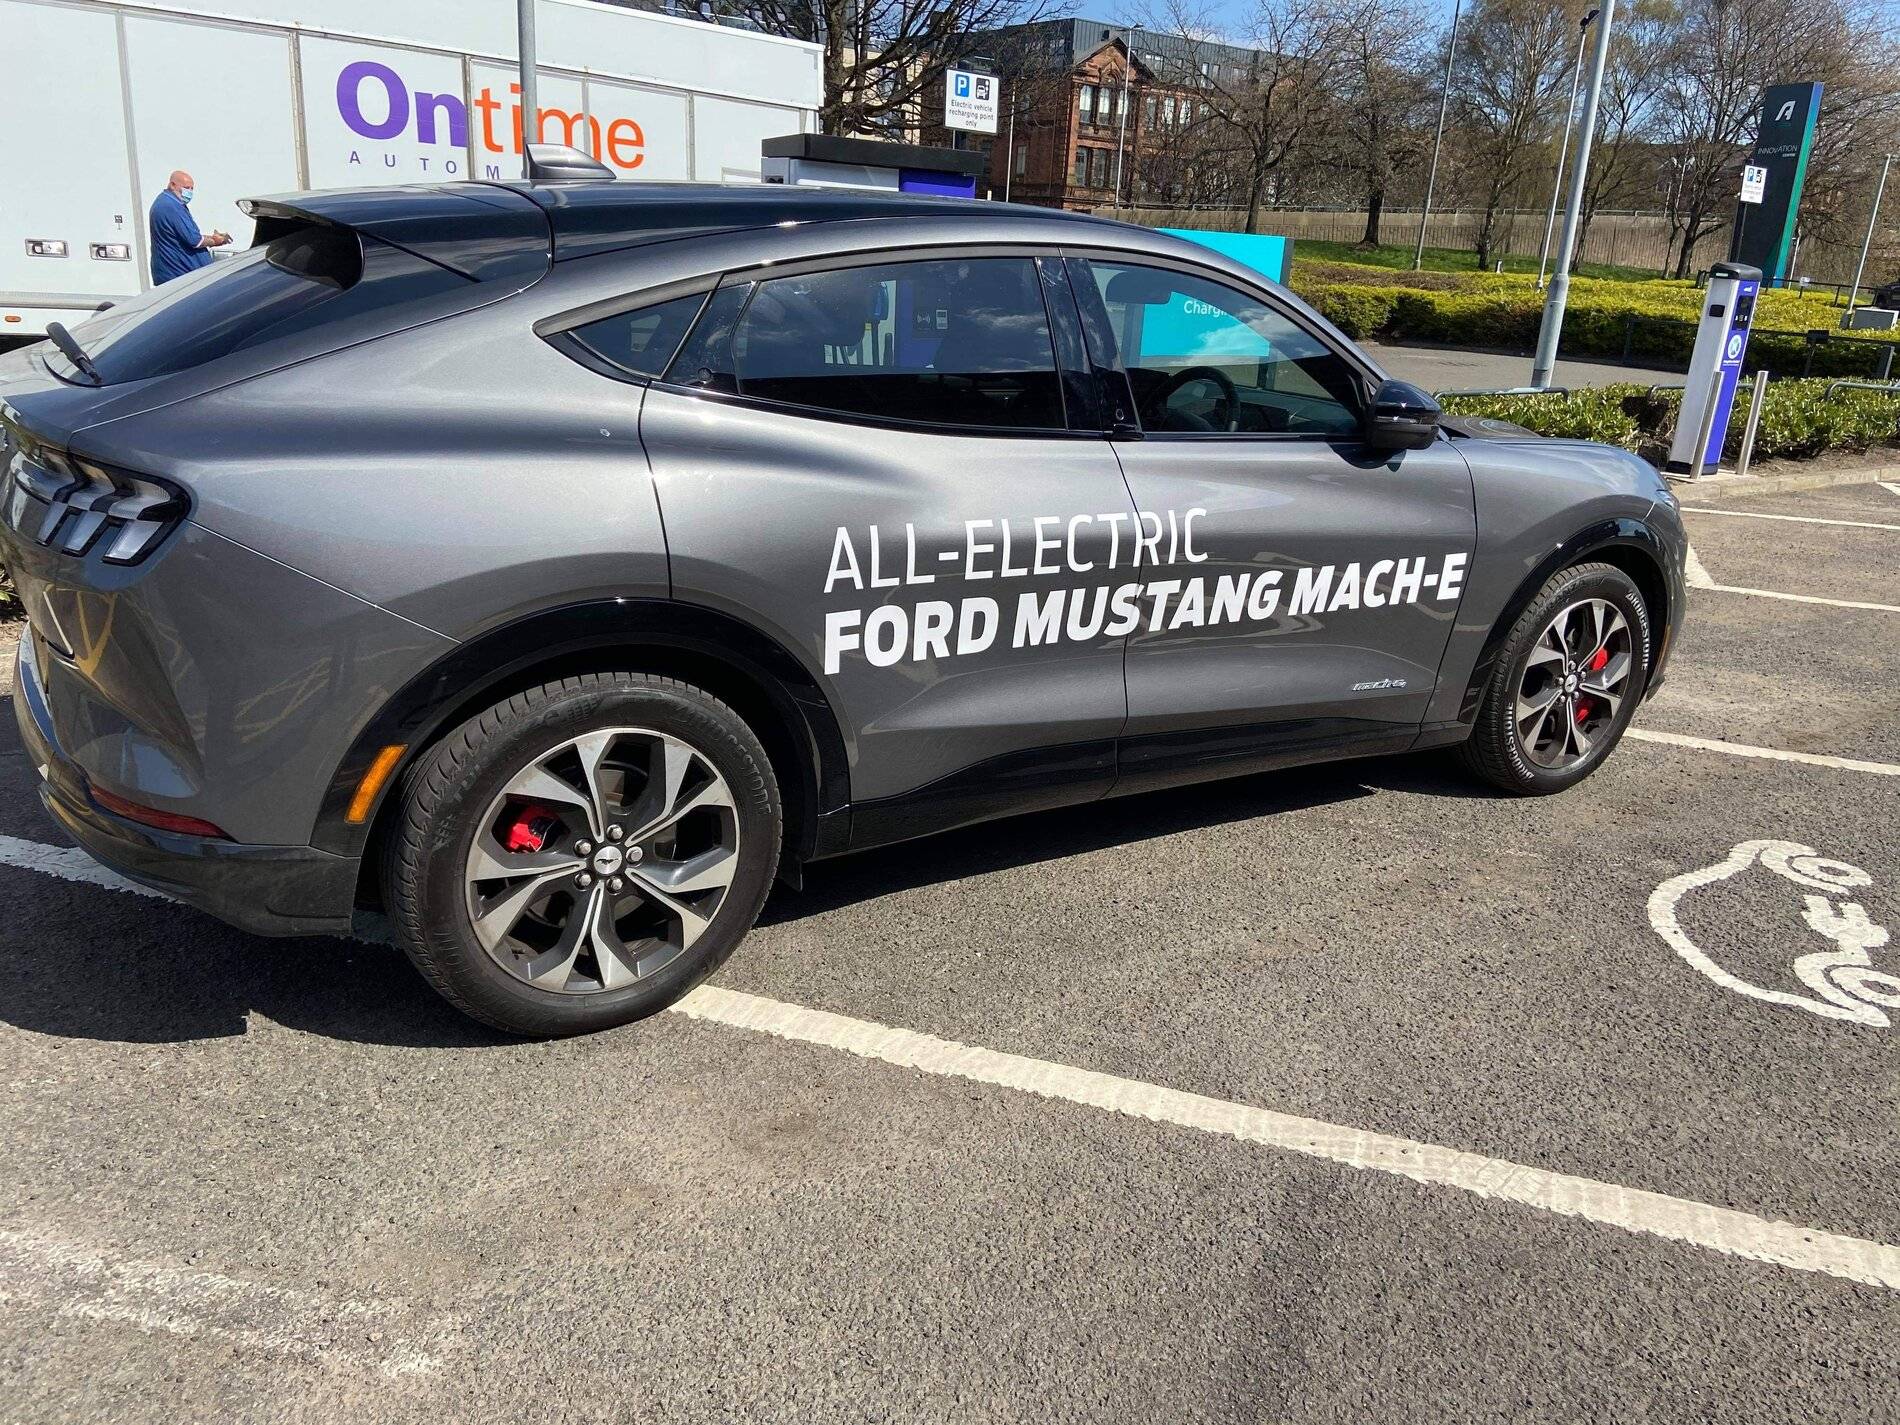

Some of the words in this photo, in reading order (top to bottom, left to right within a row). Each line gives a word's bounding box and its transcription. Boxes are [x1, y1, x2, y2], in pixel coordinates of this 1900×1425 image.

[957, 76, 968, 95] P
[336, 61, 645, 169] Ontime
[949, 109, 978, 119] recharging
[980, 113, 993, 121] point
[951, 100, 972, 109] Electric
[974, 104, 992, 112] vehicle
[1757, 144, 1798, 154] INNOVATION
[350, 151, 523, 179] AUTOM
[823, 507, 1209, 593] ALL-ELECTRIC
[824, 596, 999, 675] FORD
[1012, 570, 1284, 648] MUSTANG
[1287, 553, 1468, 617] MACH-E
